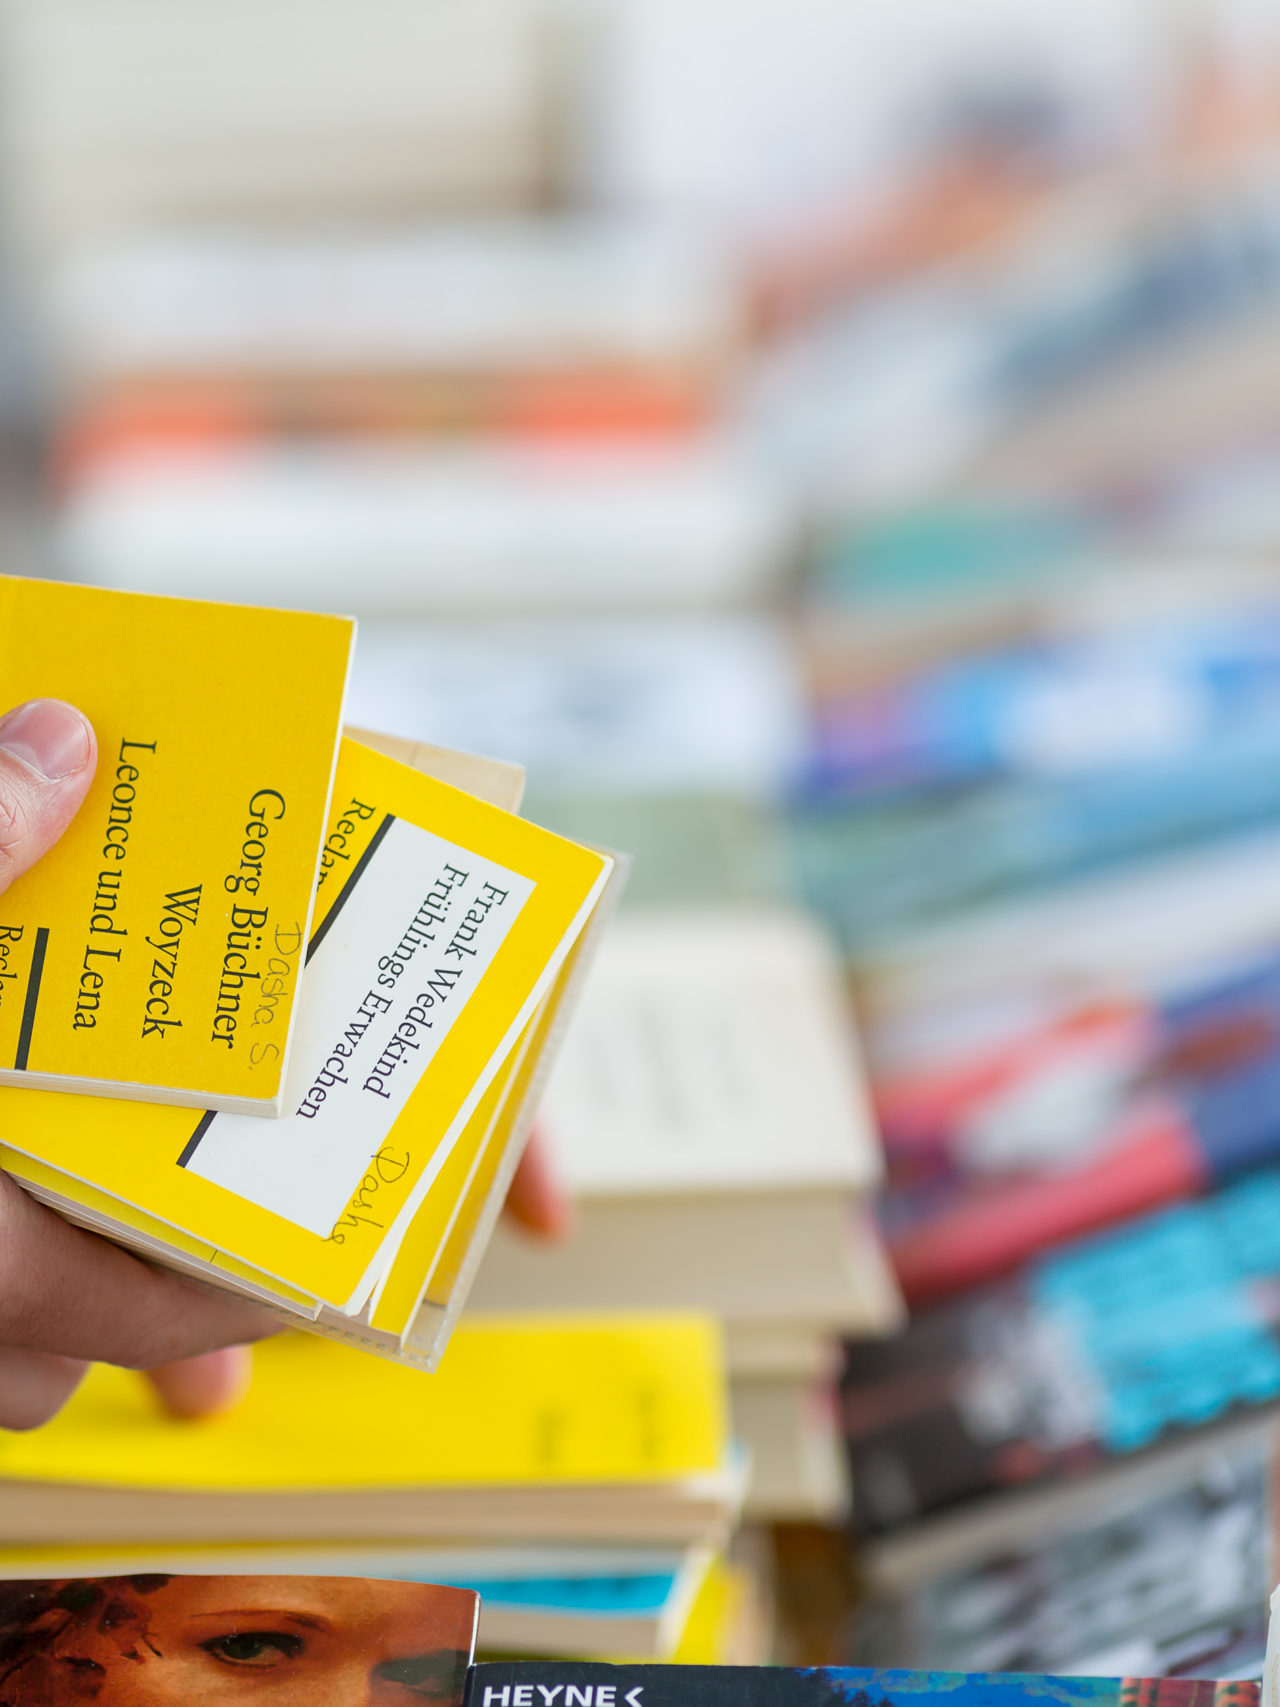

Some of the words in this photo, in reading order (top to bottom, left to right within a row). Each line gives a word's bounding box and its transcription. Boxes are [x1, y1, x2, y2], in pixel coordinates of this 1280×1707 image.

[103, 737, 157, 860] Leonce
[224, 788, 286, 897] Georg
[89, 869, 128, 936] und
[141, 883, 203, 1039] Woyzeck
[377, 864, 470, 990] Frühlings
[444, 882, 509, 961] Frank
[72, 944, 122, 1031] Lena
[210, 903, 269, 1050] Büchner
[362, 969, 463, 1099] Wedekind
[295, 990, 395, 1120] Erwachen
[483, 1685, 617, 1707] HEYNE
